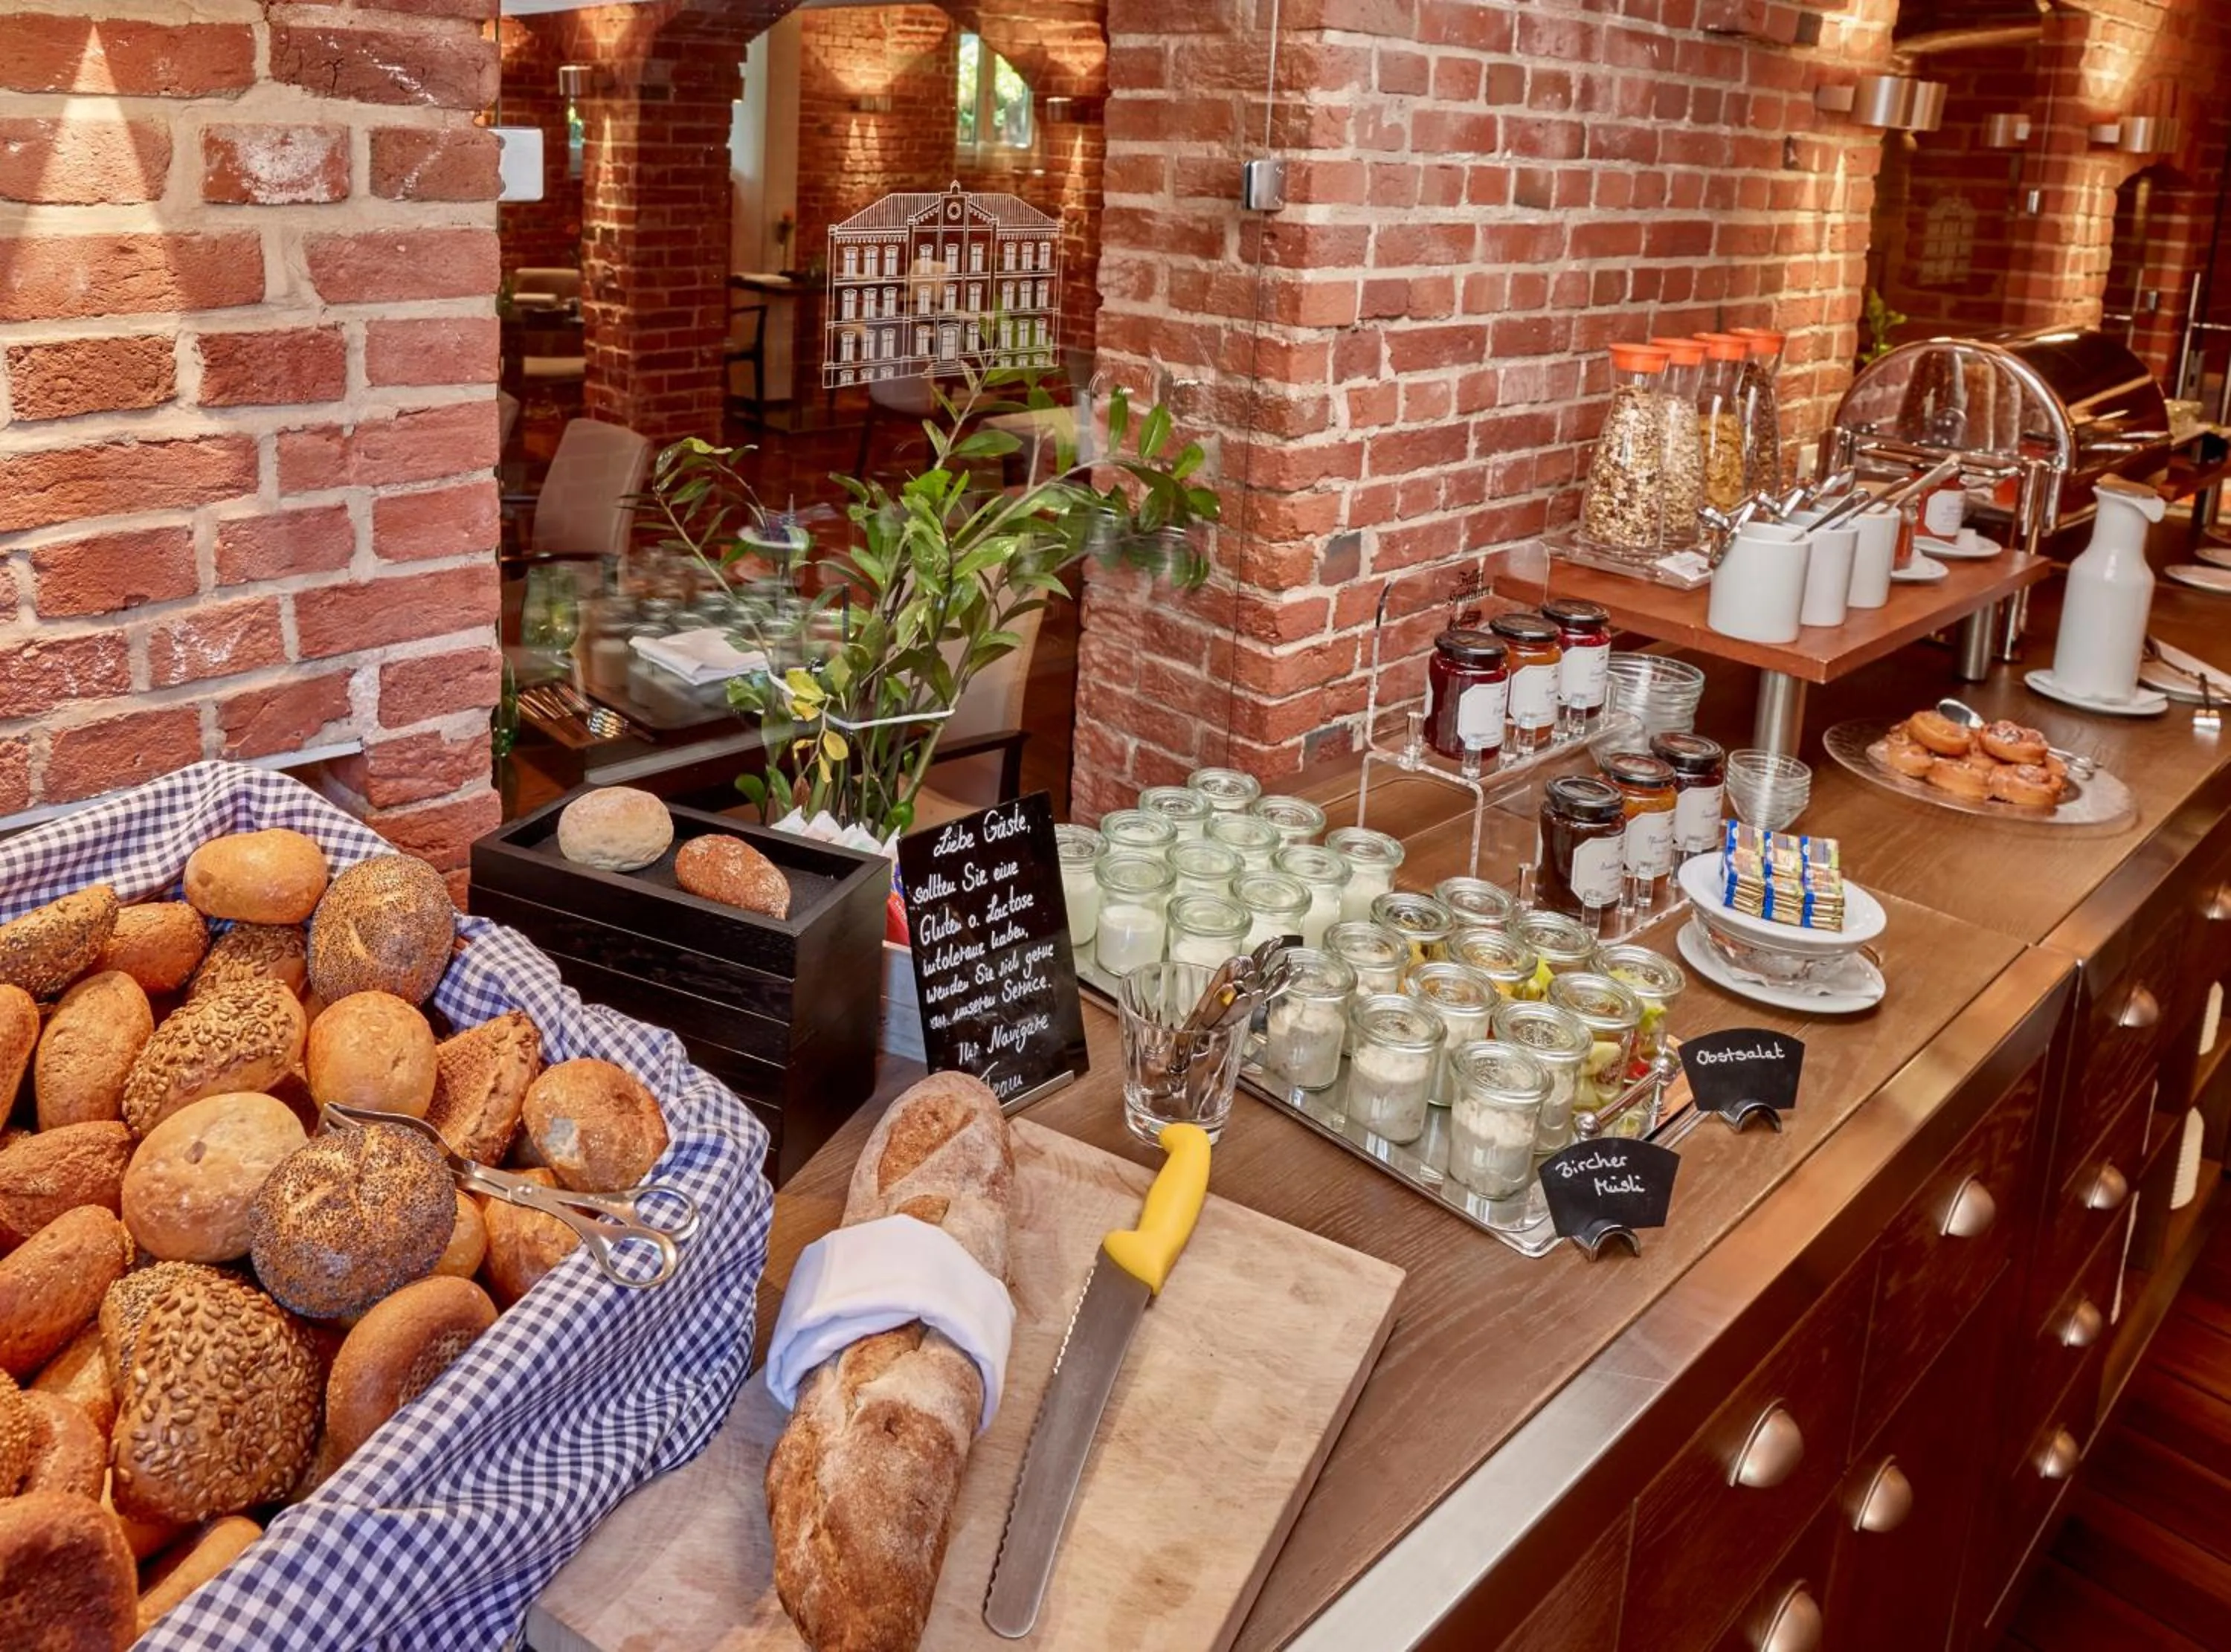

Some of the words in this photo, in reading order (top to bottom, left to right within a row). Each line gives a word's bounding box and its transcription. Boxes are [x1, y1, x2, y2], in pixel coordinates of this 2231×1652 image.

[933, 825, 975, 856] Liebe
[983, 803, 1031, 842] Gäste,
[913, 874, 956, 905] sollten
[962, 862, 988, 891] Sie
[993, 862, 1020, 881] eine
[920, 906, 962, 946] Gluten
[968, 914, 980, 929] o.
[985, 885, 1034, 923] Lactose
[991, 920, 1028, 949] haben,
[975, 963, 995, 984] Sie
[998, 949, 1019, 977] sich
[1023, 943, 1054, 979] gerne
[1002, 975, 1052, 1002] Service.
[987, 1014, 1049, 1054] Navigare
[1696, 1041, 1785, 1065] Obstsalat
[1555, 1152, 1627, 1178] Bircher
[1594, 1175, 1645, 1196] Müsli
